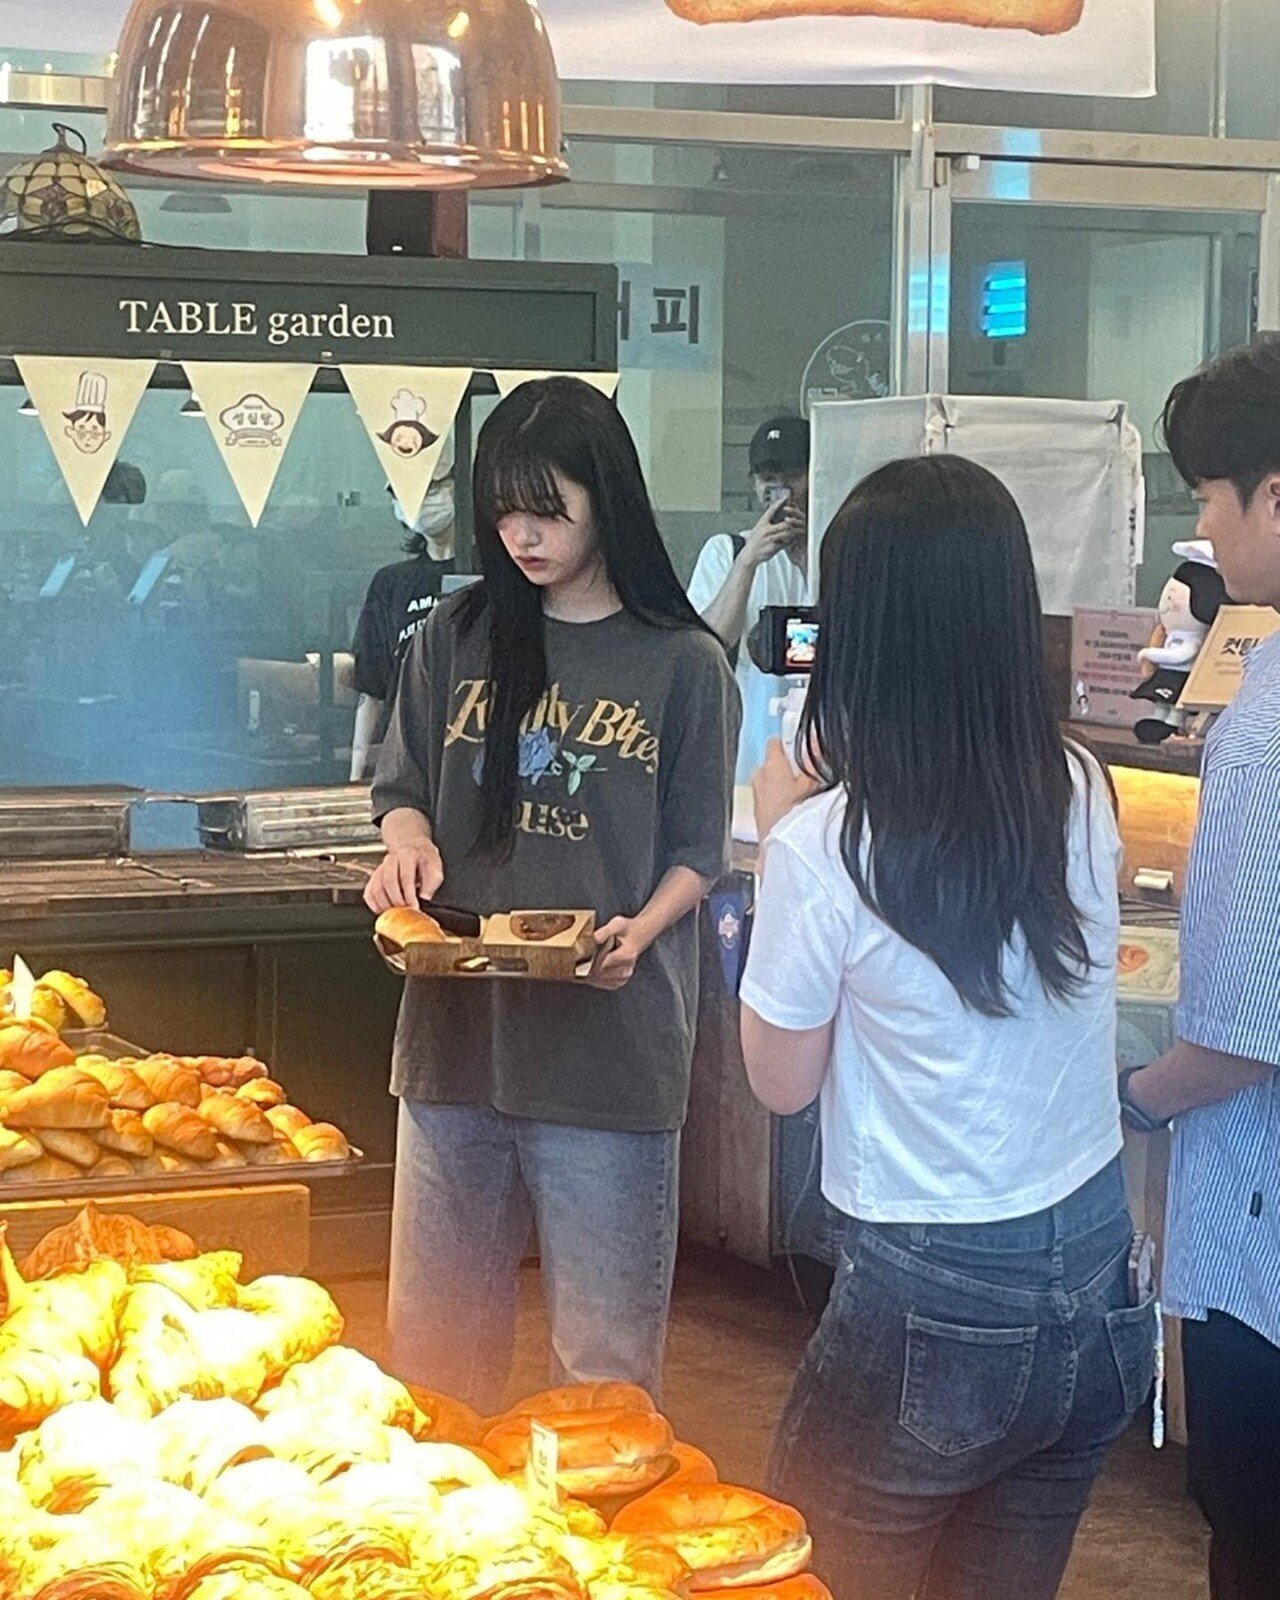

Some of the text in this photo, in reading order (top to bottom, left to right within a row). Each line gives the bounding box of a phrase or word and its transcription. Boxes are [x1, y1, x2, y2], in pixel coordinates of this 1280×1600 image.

[119, 300, 394, 345] TABLE garden
[516, 800, 590, 841] use
